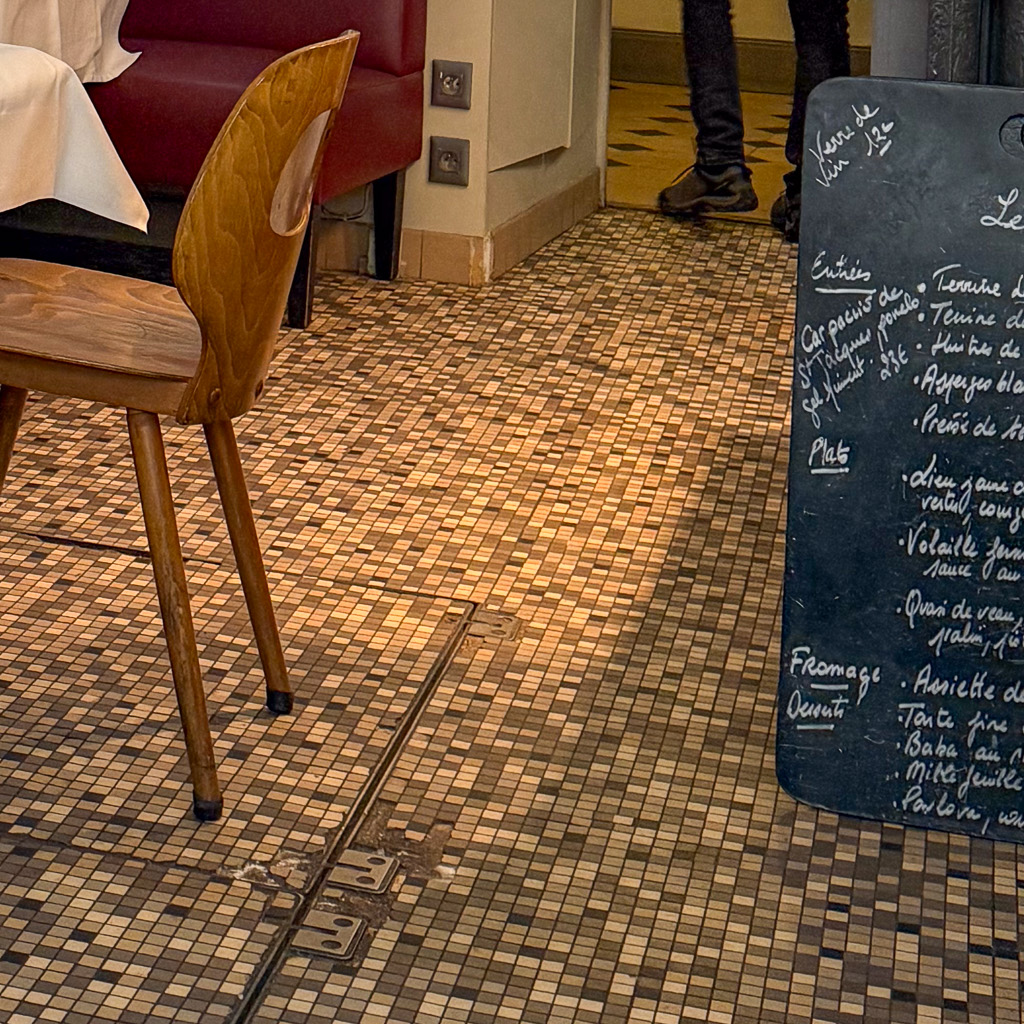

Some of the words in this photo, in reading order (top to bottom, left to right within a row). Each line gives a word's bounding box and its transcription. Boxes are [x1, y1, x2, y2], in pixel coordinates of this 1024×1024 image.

[852, 104, 880, 127] de
[816, 159, 850, 188] Vin
[811, 250, 872, 281] Entrées
[932, 263, 1002, 297] Terrine
[878, 284, 903, 307] de
[930, 300, 996, 326] Terrine
[999, 338, 1021, 359] de
[921, 363, 993, 404] Asperges
[973, 415, 997, 437] de
[960, 475, 1009, 515] jaune
[907, 520, 979, 557] Volaille
[923, 559, 972, 578] sauce
[996, 566, 1021, 581] au
[905, 588, 947, 630] Quasi
[951, 598, 974, 619] de
[790, 646, 881, 706] Fromage
[913, 663, 996, 701] Assiette
[898, 702, 955, 728] Tarte
[967, 710, 1008, 748] fine
[904, 730, 959, 758] Baba
[974, 747, 1001, 762] au
